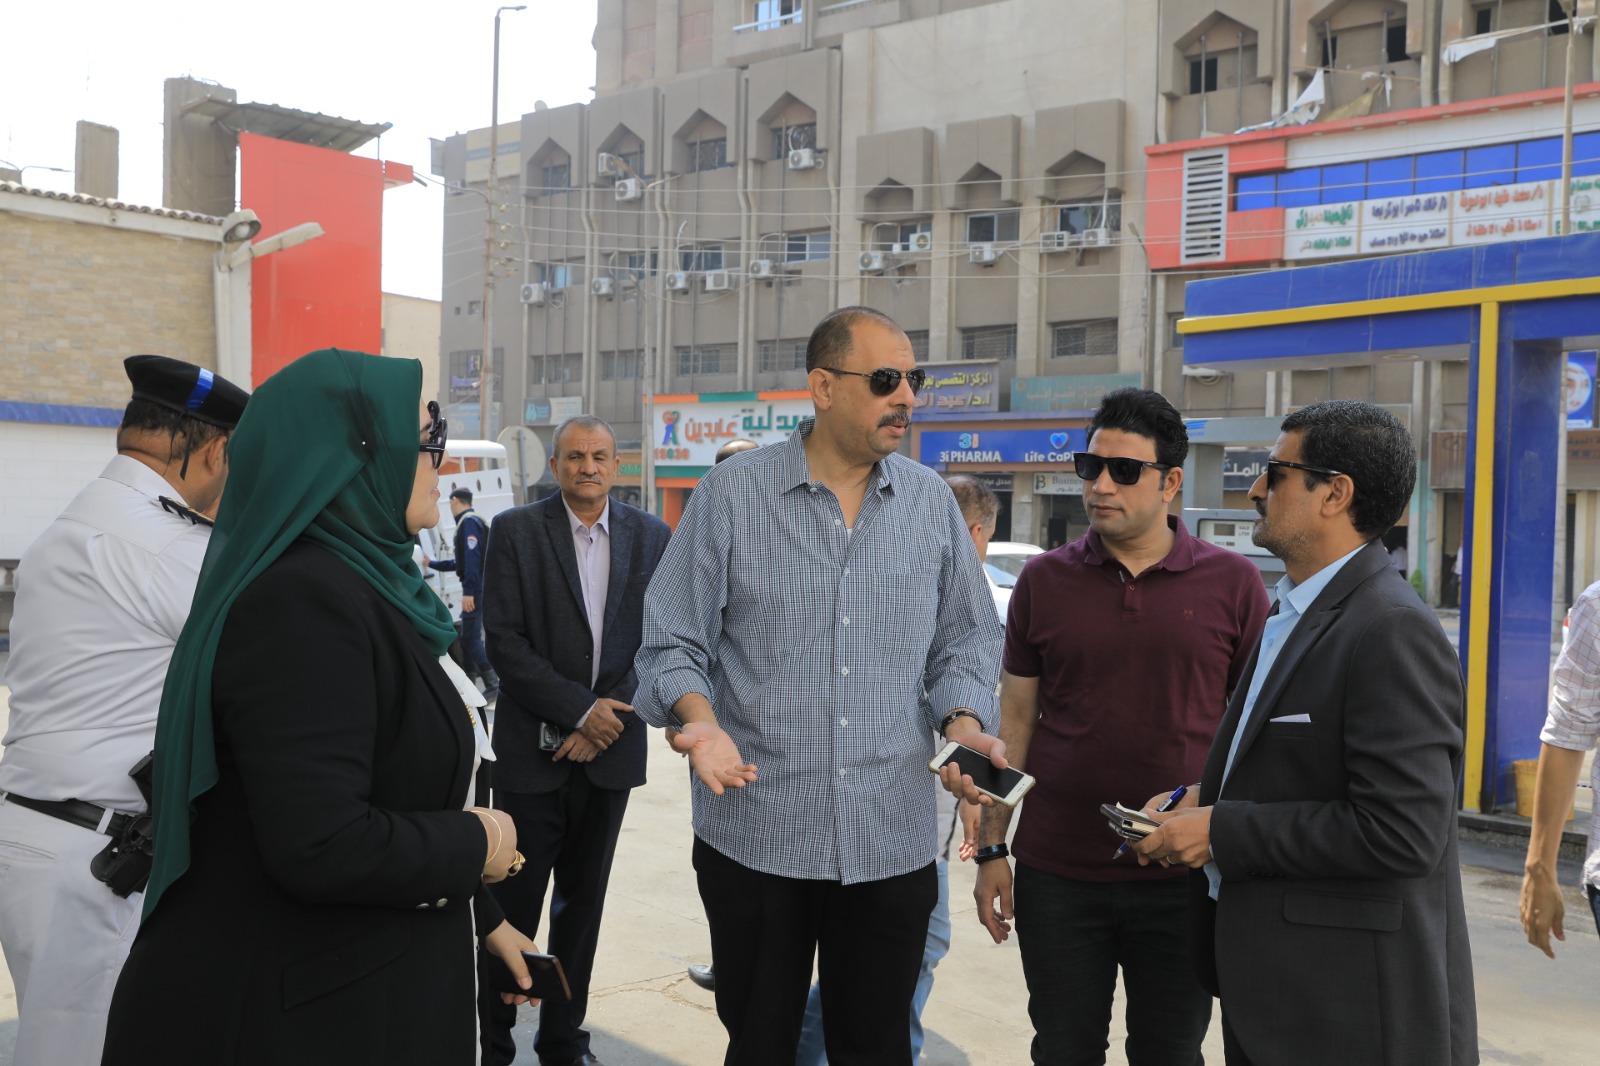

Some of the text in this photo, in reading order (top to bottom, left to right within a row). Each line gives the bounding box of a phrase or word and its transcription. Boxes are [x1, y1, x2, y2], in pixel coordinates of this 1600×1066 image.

[685, 417, 737, 444] عابدين
[951, 450, 1002, 462] PHARMA
[1024, 451, 1045, 462] Life
